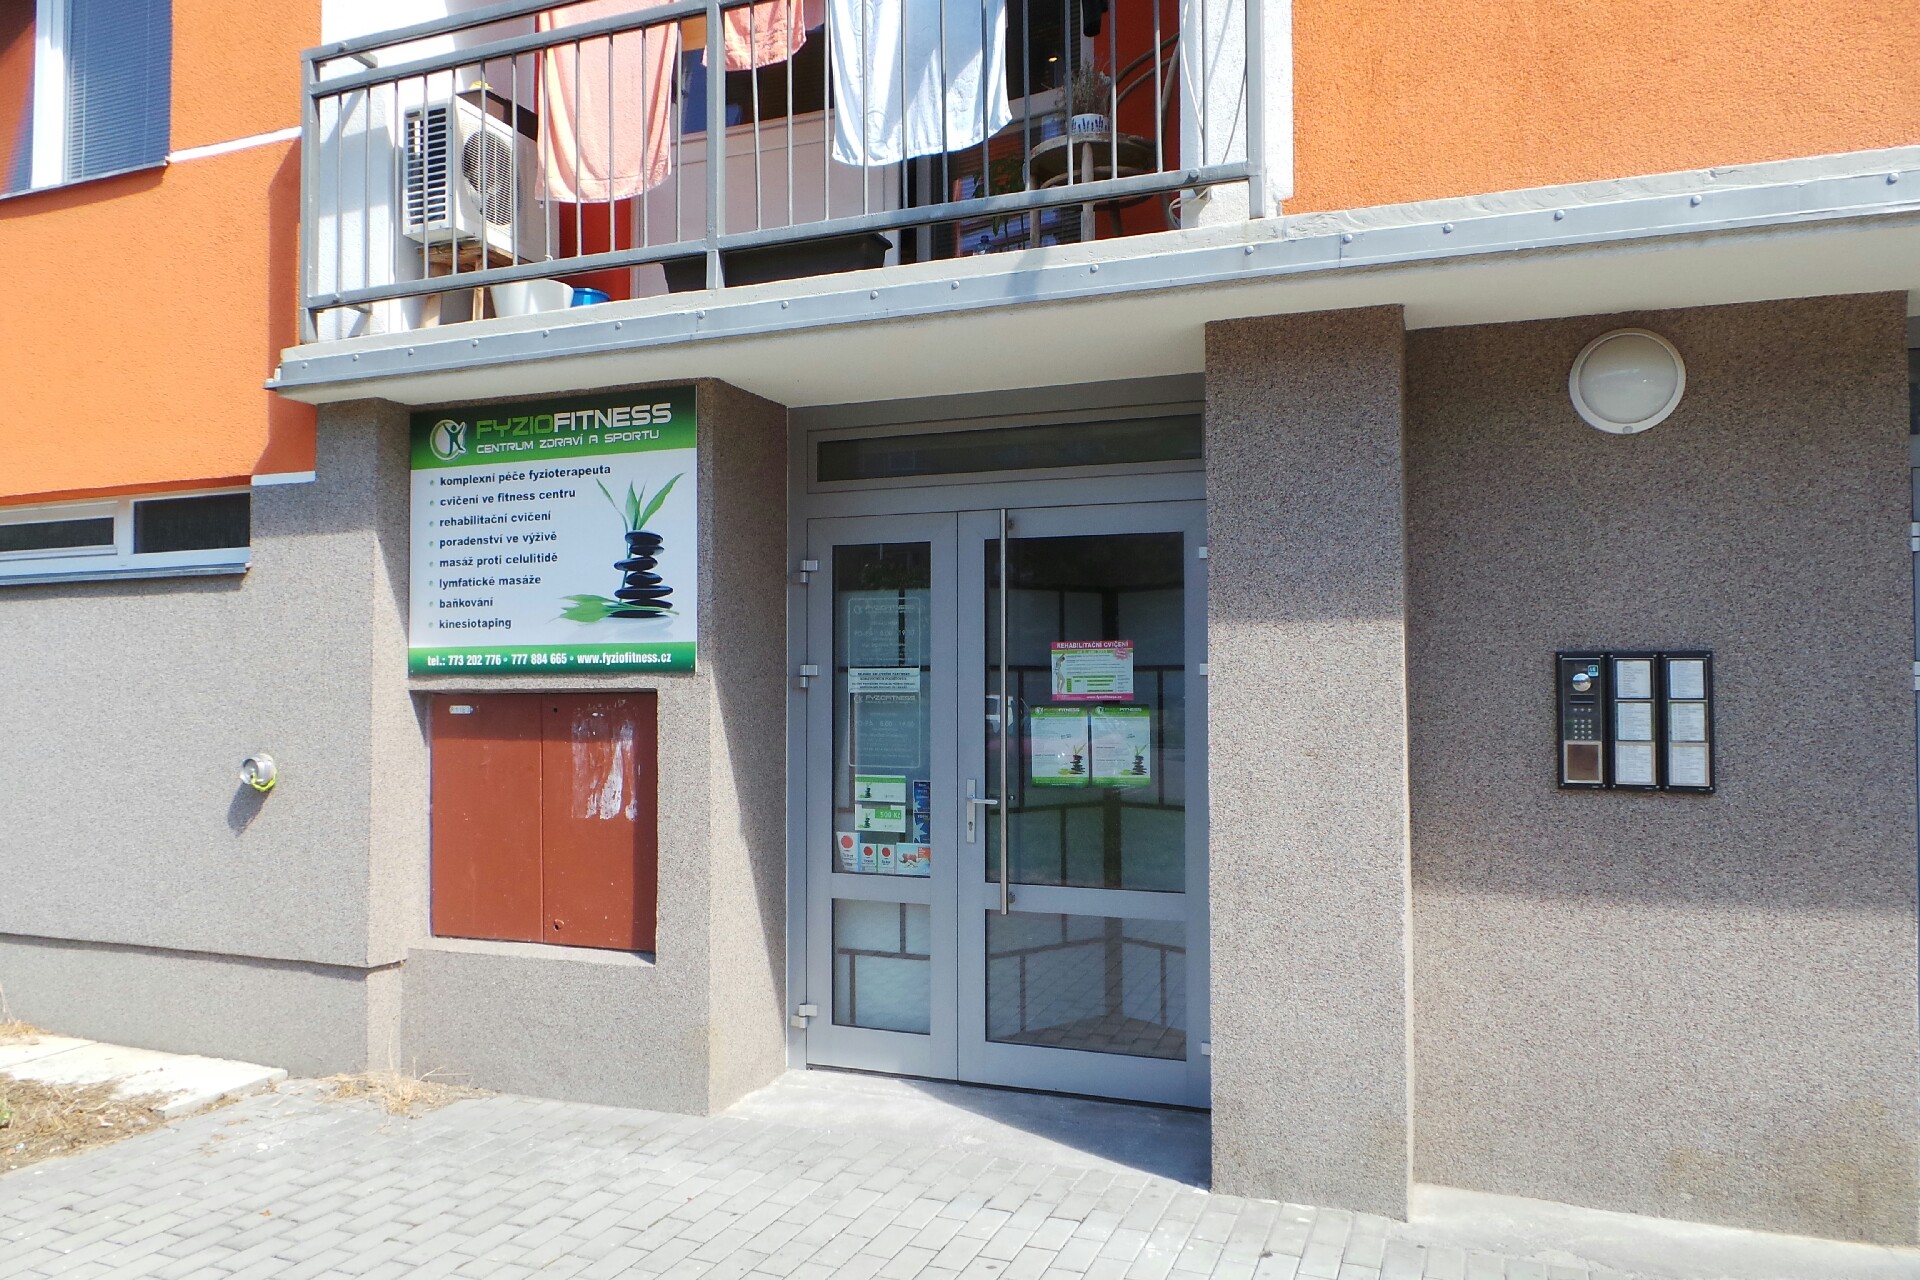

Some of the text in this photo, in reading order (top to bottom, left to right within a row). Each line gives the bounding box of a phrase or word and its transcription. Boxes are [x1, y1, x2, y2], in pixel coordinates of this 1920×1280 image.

[476, 402, 672, 440] FYZIOFITNESS
[476, 429, 660, 455] CENTRUM ZDRAVÍ A SPORTU
[440, 464, 612, 488] komplexní péče fyzioterapeuta
[440, 488, 576, 507] cvičení ve fitness centru
[439, 510, 551, 527] rehabilitační cvičení
[439, 531, 557, 549] poradenství ve výživě
[439, 552, 558, 568] masáž proti celulitidě
[439, 574, 542, 590] lymfatické masáže
[439, 597, 493, 609] baňkování
[439, 617, 512, 630] kinesiotaping
[1056, 640, 1128, 649] REHABILITAČNÍ CVIČENÍ
[427, 651, 672, 667] tel.: 773 202 776 777 884 665 www.fyziofitness.cz
